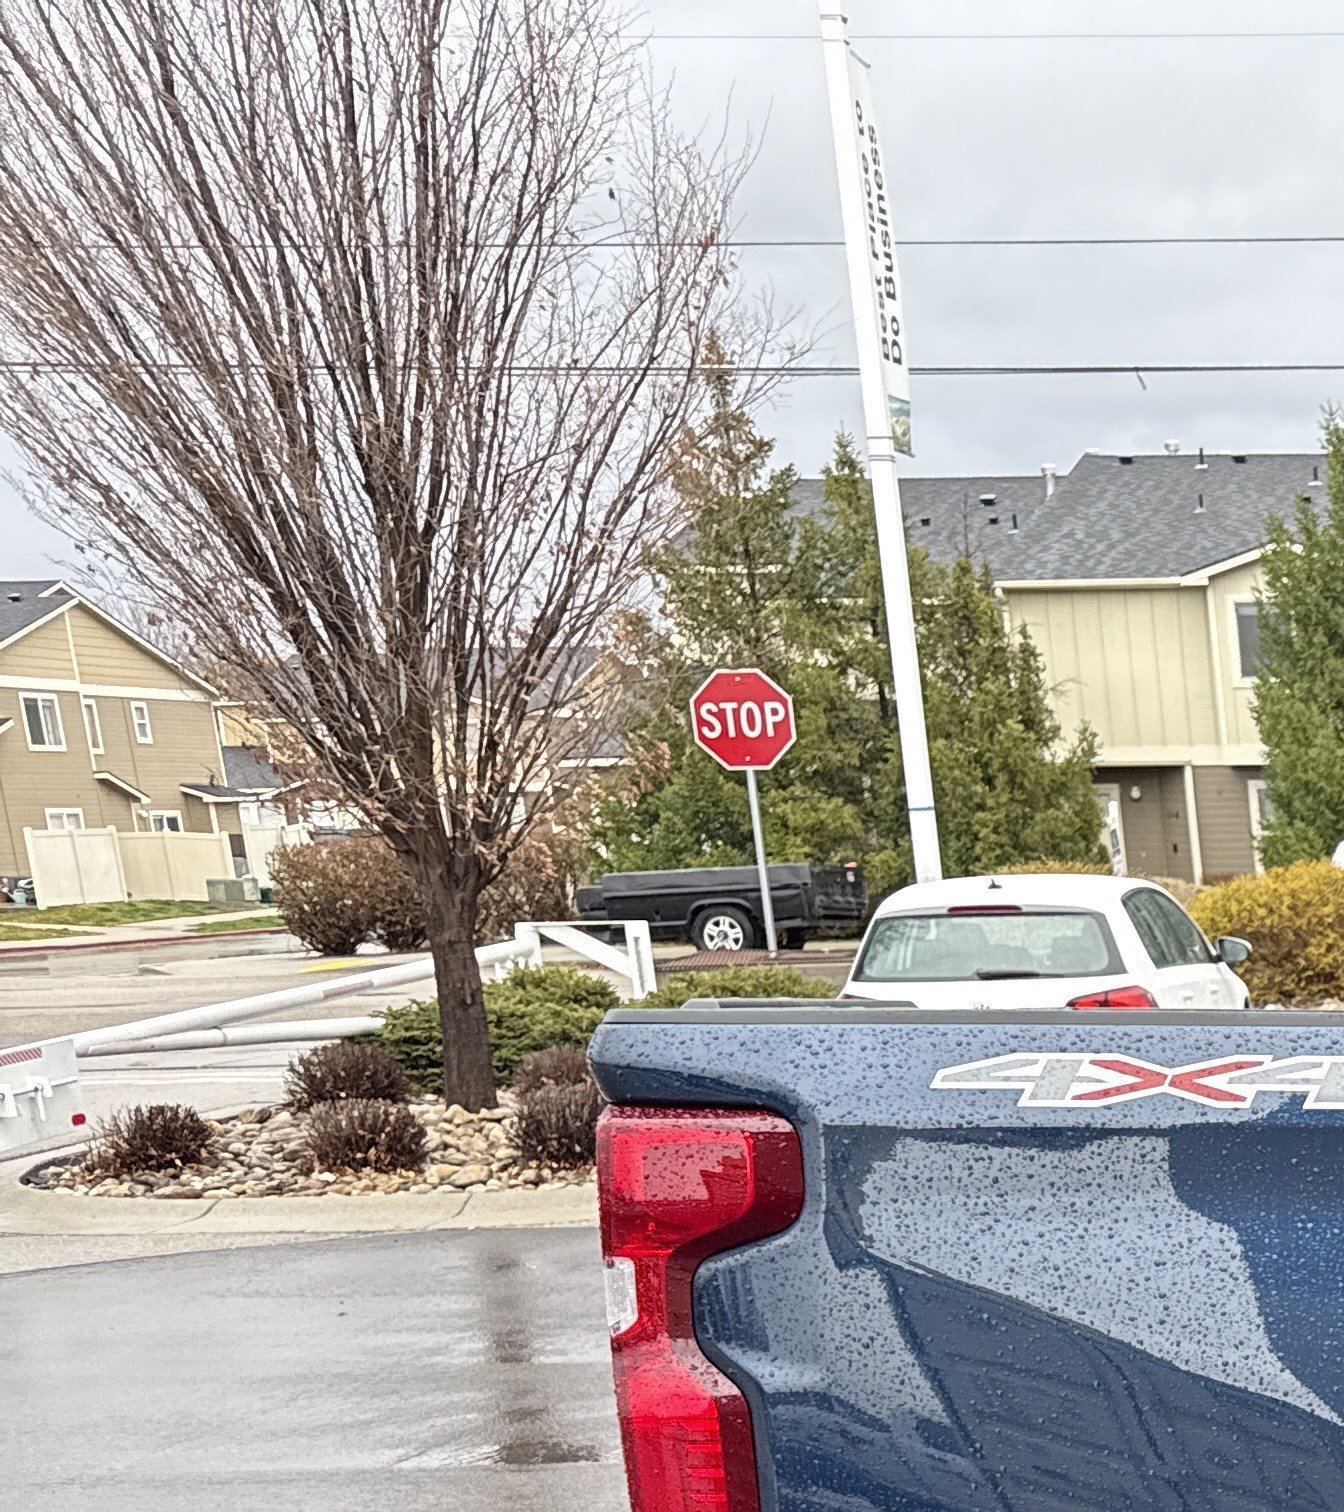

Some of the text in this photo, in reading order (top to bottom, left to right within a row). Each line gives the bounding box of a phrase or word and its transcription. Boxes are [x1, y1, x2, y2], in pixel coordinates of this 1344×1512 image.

[867, 125, 902, 365] Do Business
[700, 701, 785, 739] STOP
